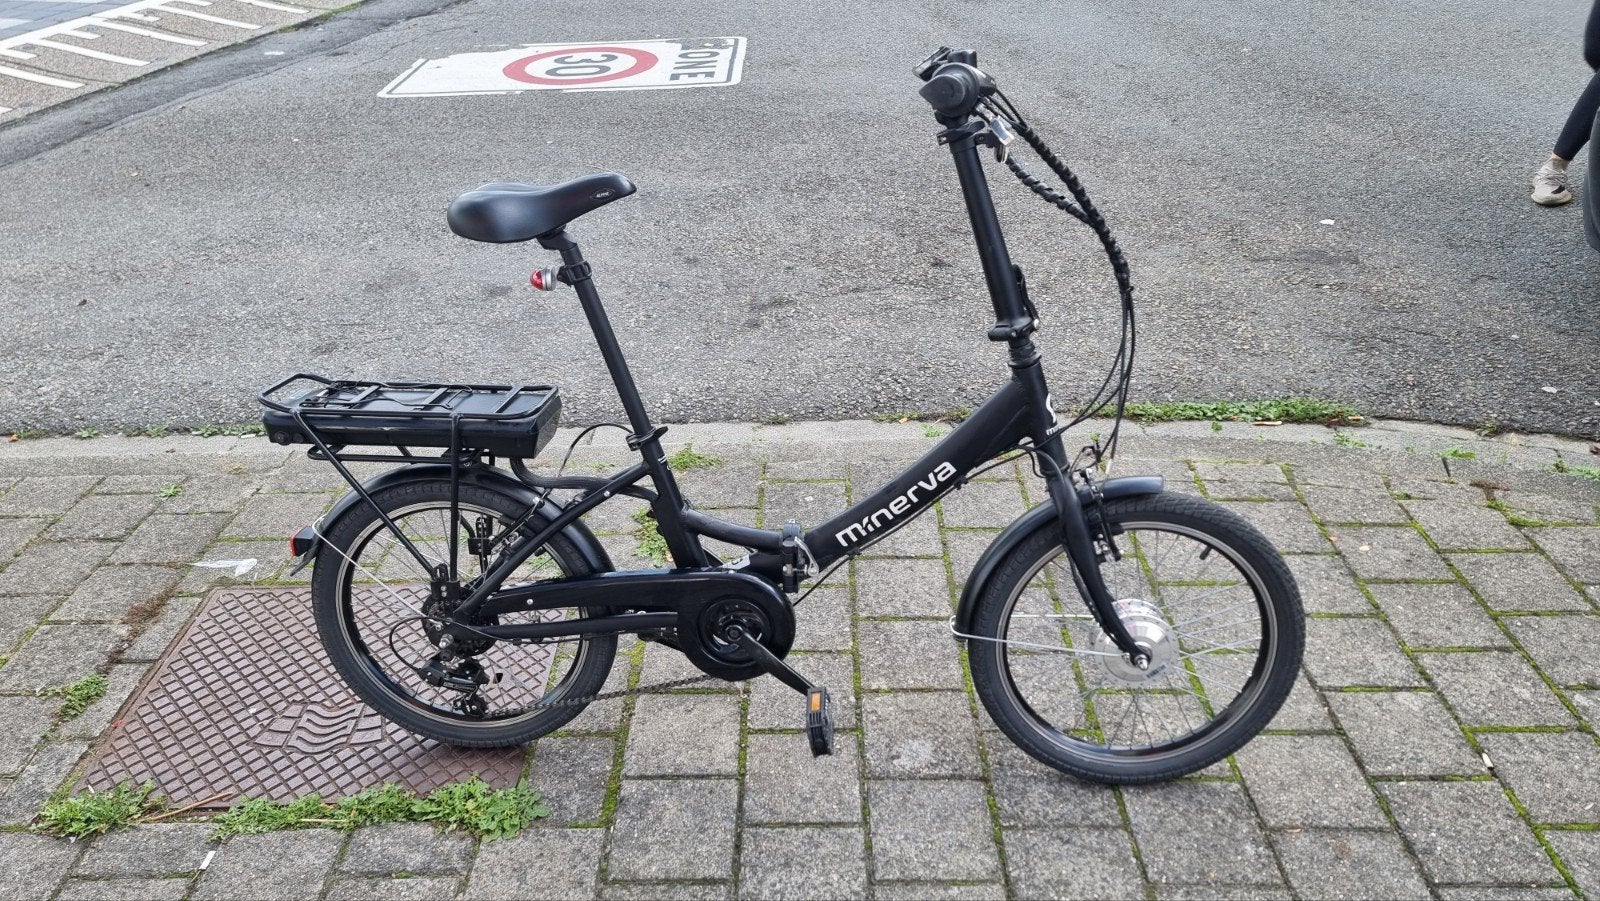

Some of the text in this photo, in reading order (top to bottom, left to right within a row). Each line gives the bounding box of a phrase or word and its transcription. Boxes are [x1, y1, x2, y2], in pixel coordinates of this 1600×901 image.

[545, 53, 618, 77] 30
[669, 45, 720, 81] ONE
[835, 461, 957, 547] minerva
